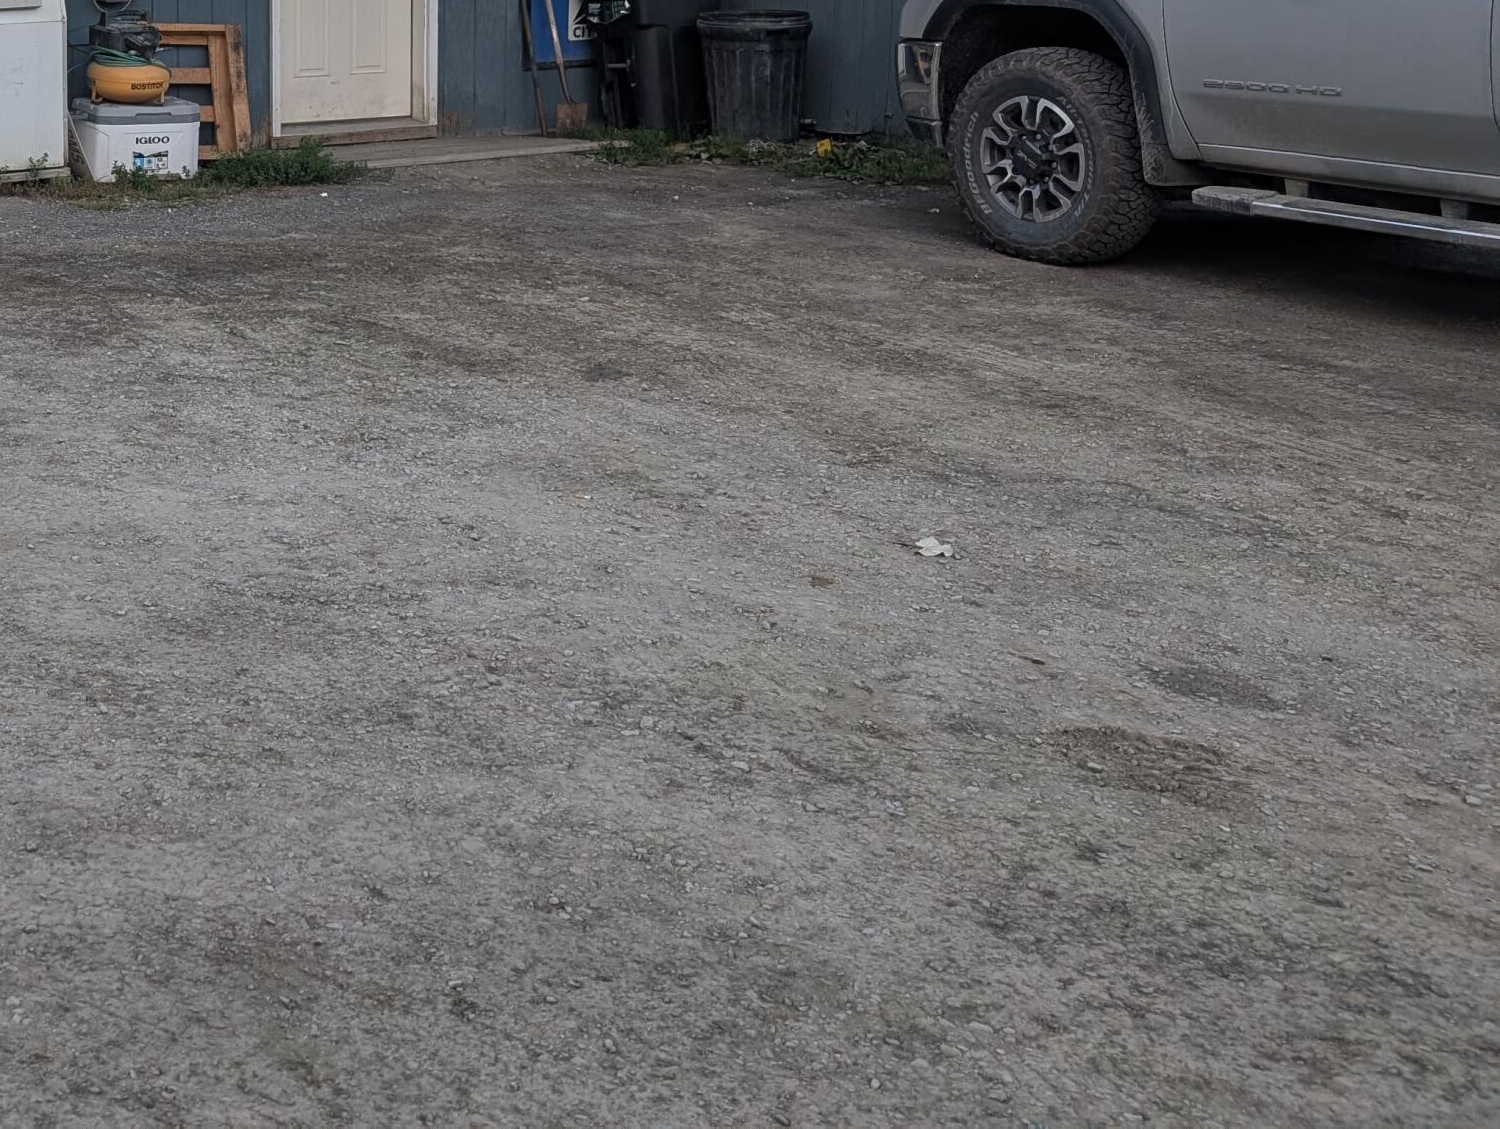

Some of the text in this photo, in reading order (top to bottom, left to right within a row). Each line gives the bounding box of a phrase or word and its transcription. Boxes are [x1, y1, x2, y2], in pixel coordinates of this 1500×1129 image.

[1203, 78, 1343, 98] 2500 HD
[135, 135, 171, 145] IGLOO
[963, 111, 993, 214] BFGoodrich
